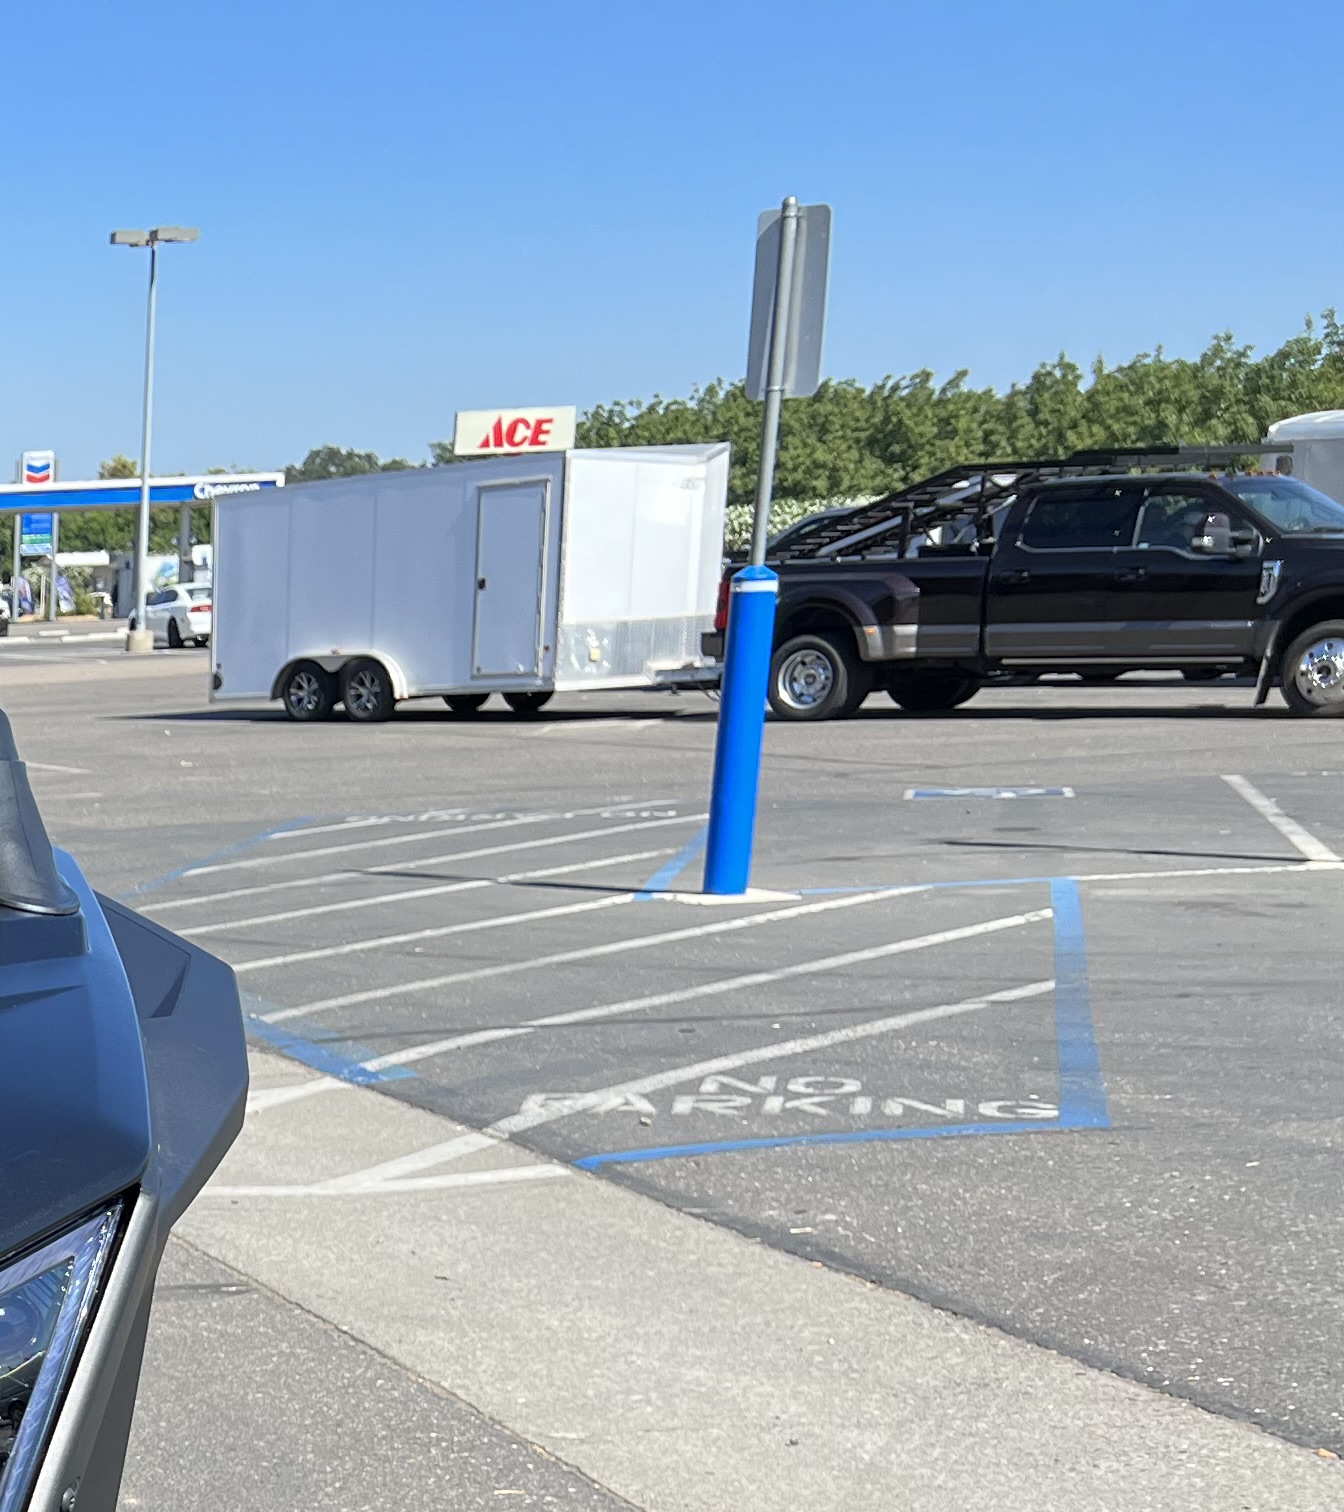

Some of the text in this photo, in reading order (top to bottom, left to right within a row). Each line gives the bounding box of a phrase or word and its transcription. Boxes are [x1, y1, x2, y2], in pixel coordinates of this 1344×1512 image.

[478, 415, 554, 448] ACE
[699, 1074, 862, 1094] NO
[518, 1093, 1060, 1120] PARKING
